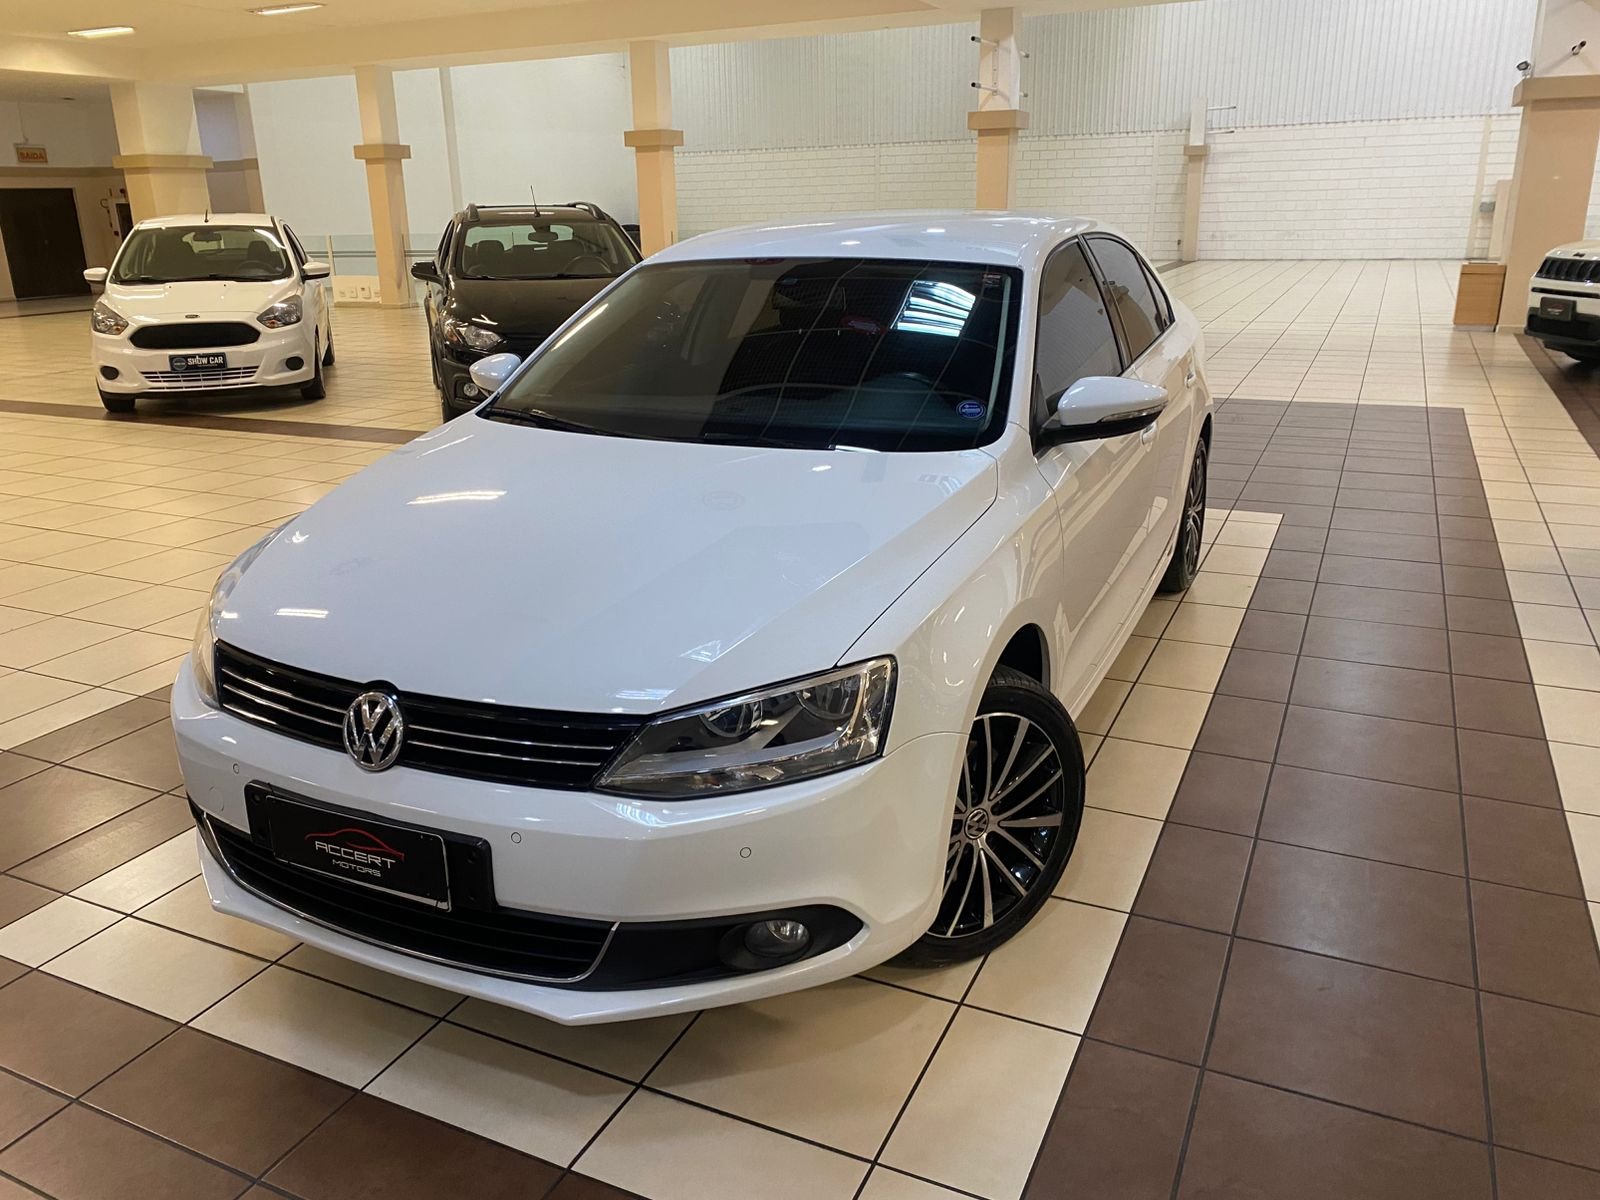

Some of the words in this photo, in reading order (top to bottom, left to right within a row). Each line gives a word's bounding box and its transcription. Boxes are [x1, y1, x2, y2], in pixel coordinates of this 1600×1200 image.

[187, 355, 207, 365] SHOW
[209, 356, 223, 364] CAR
[315, 841, 396, 869] ACCERT
[332, 859, 381, 877] MOTORS
